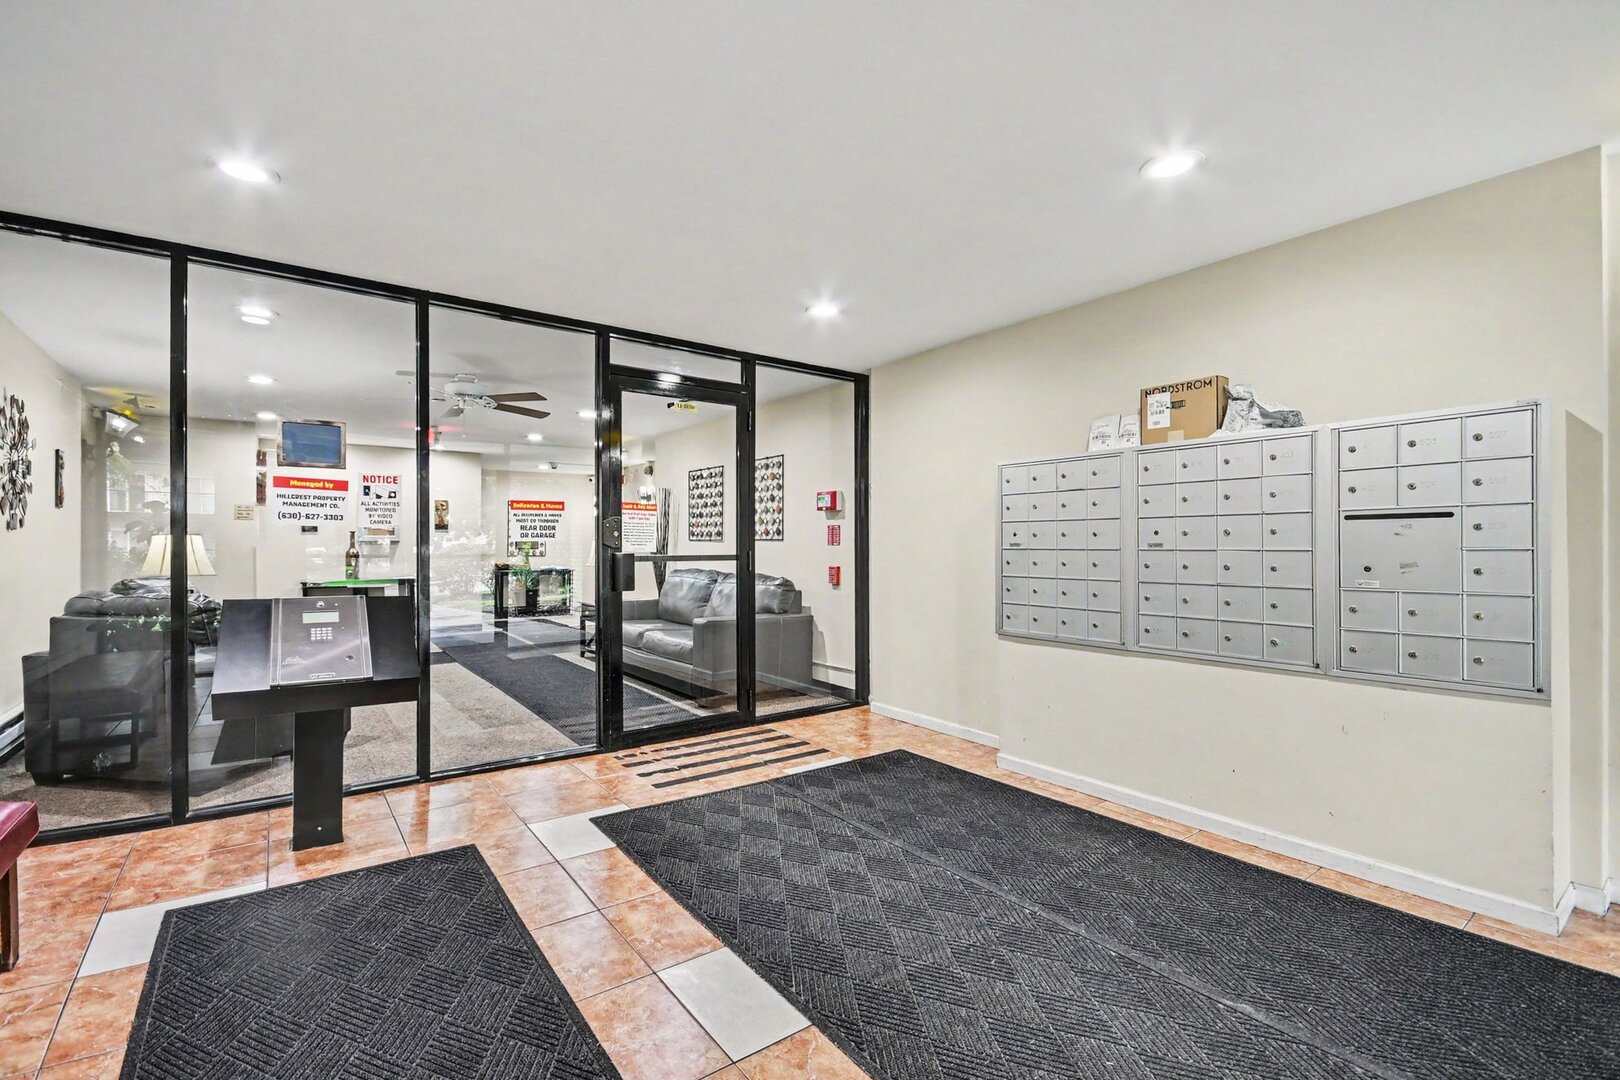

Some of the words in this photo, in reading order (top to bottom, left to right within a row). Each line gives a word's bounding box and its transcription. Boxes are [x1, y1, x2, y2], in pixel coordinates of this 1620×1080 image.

[1145, 378, 1213, 398] NORDSTROM
[289, 479, 323, 488] Managed
[324, 481, 334, 489] by
[362, 475, 399, 484] NOTICE
[276, 493, 312, 501] HILLCREST
[312, 494, 346, 502] PROPERTY
[282, 501, 328, 509] MANAGEMENT
